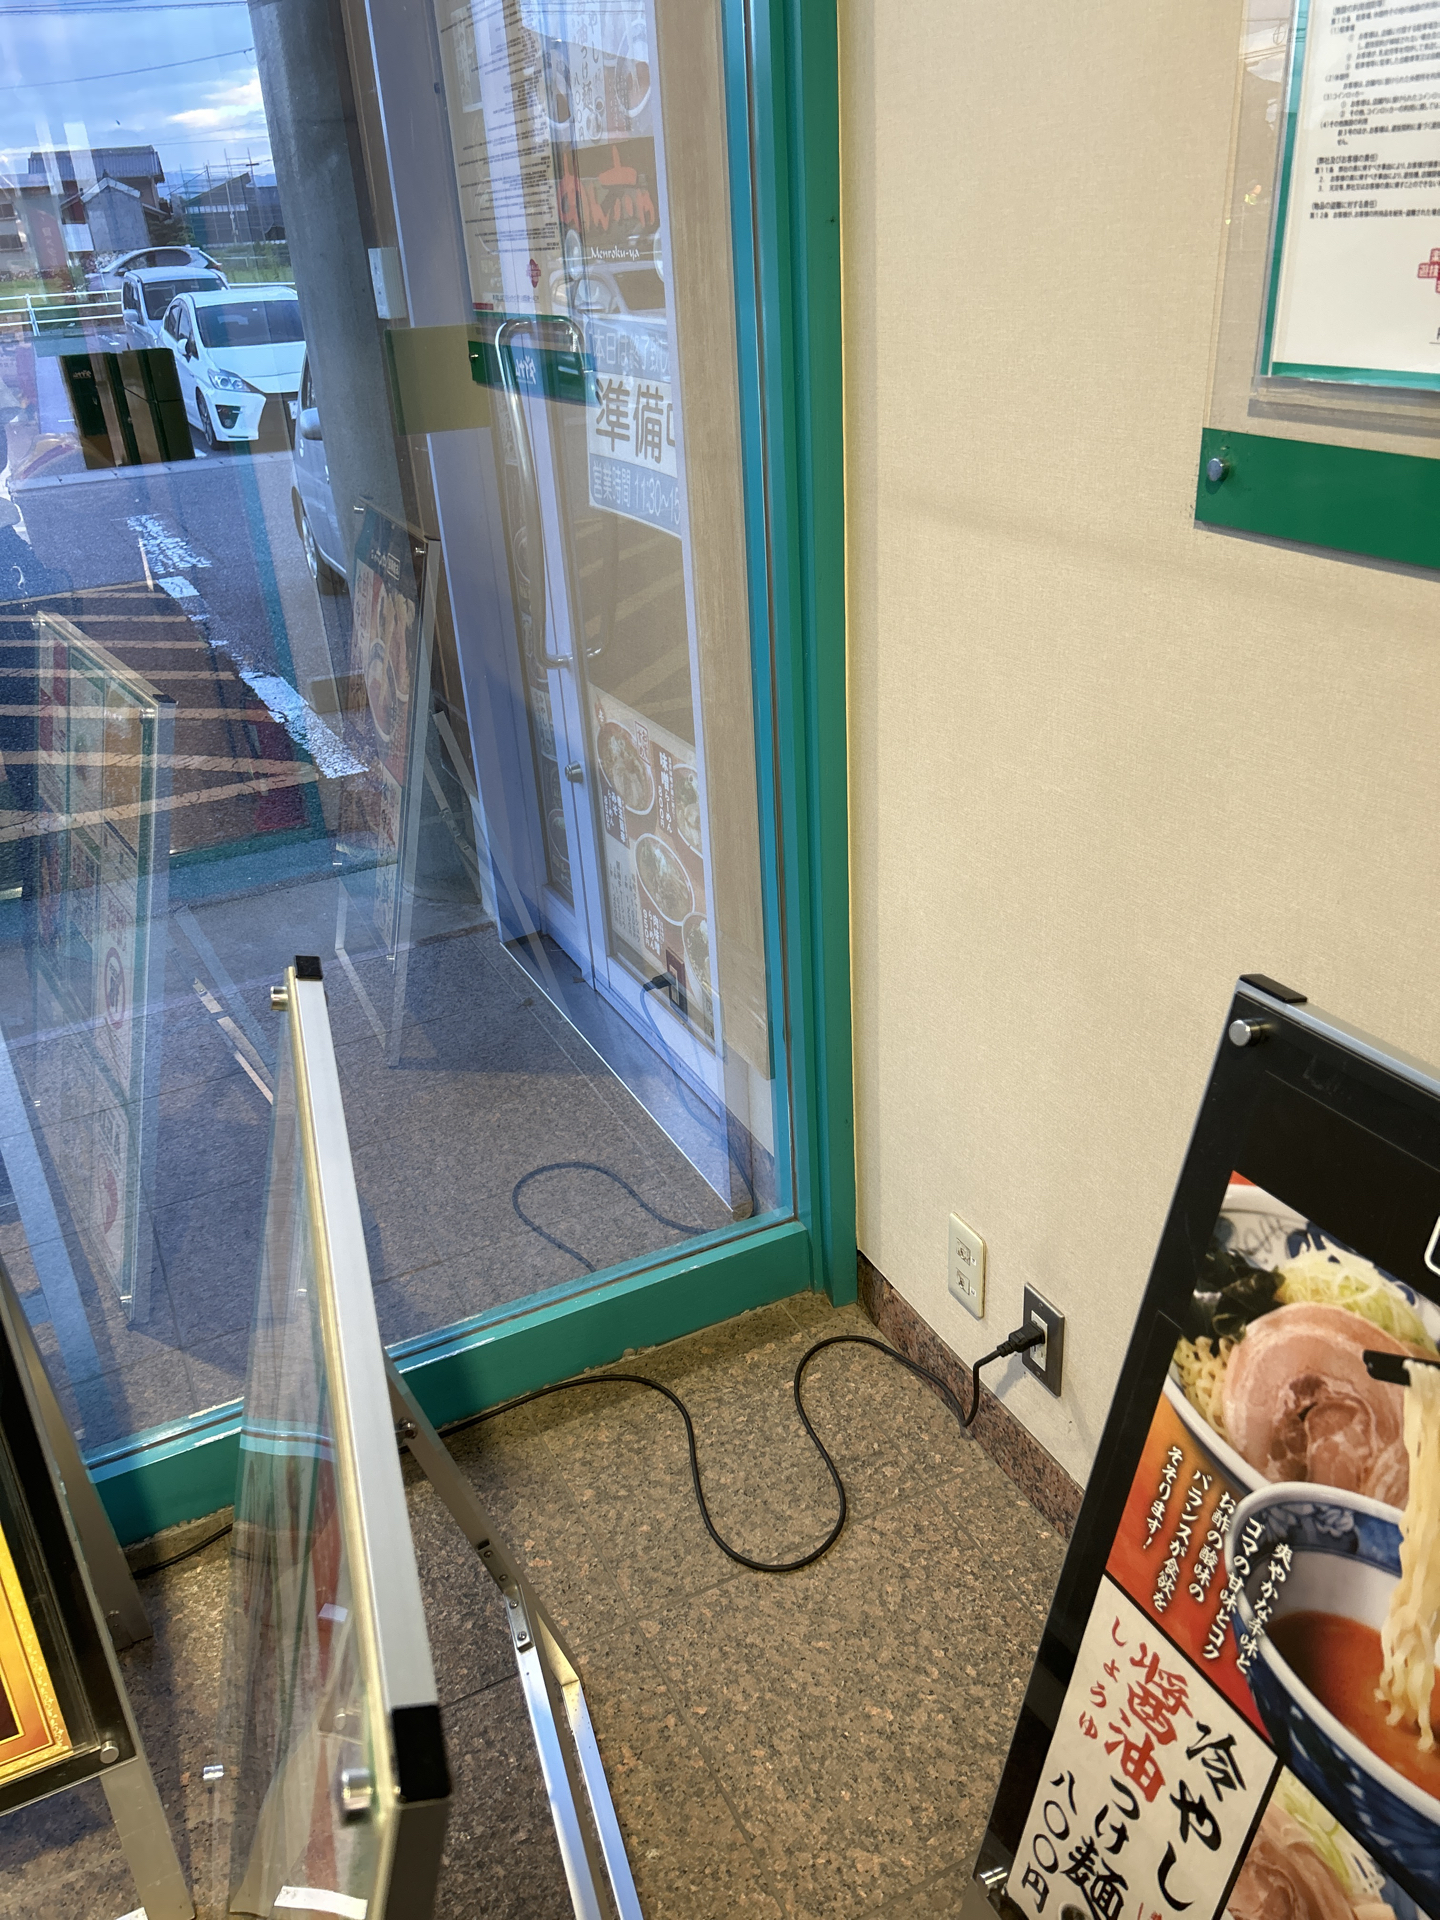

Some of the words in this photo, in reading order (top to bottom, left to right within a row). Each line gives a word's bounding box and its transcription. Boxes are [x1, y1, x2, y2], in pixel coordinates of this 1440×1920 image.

[590, 245, 640, 261] Menroku-ya
[593, 461, 631, 507] 営業時間
[1153, 1470, 1212, 1613] バランスが食欲を
[1189, 1491, 1236, 1602] お酢の酸味の
[1203, 1518, 1265, 1660] ゴマの甘味とコク
[1236, 1543, 1293, 1674] 爽やかな辛味と
[1157, 1721, 1246, 1911] 冷やし
